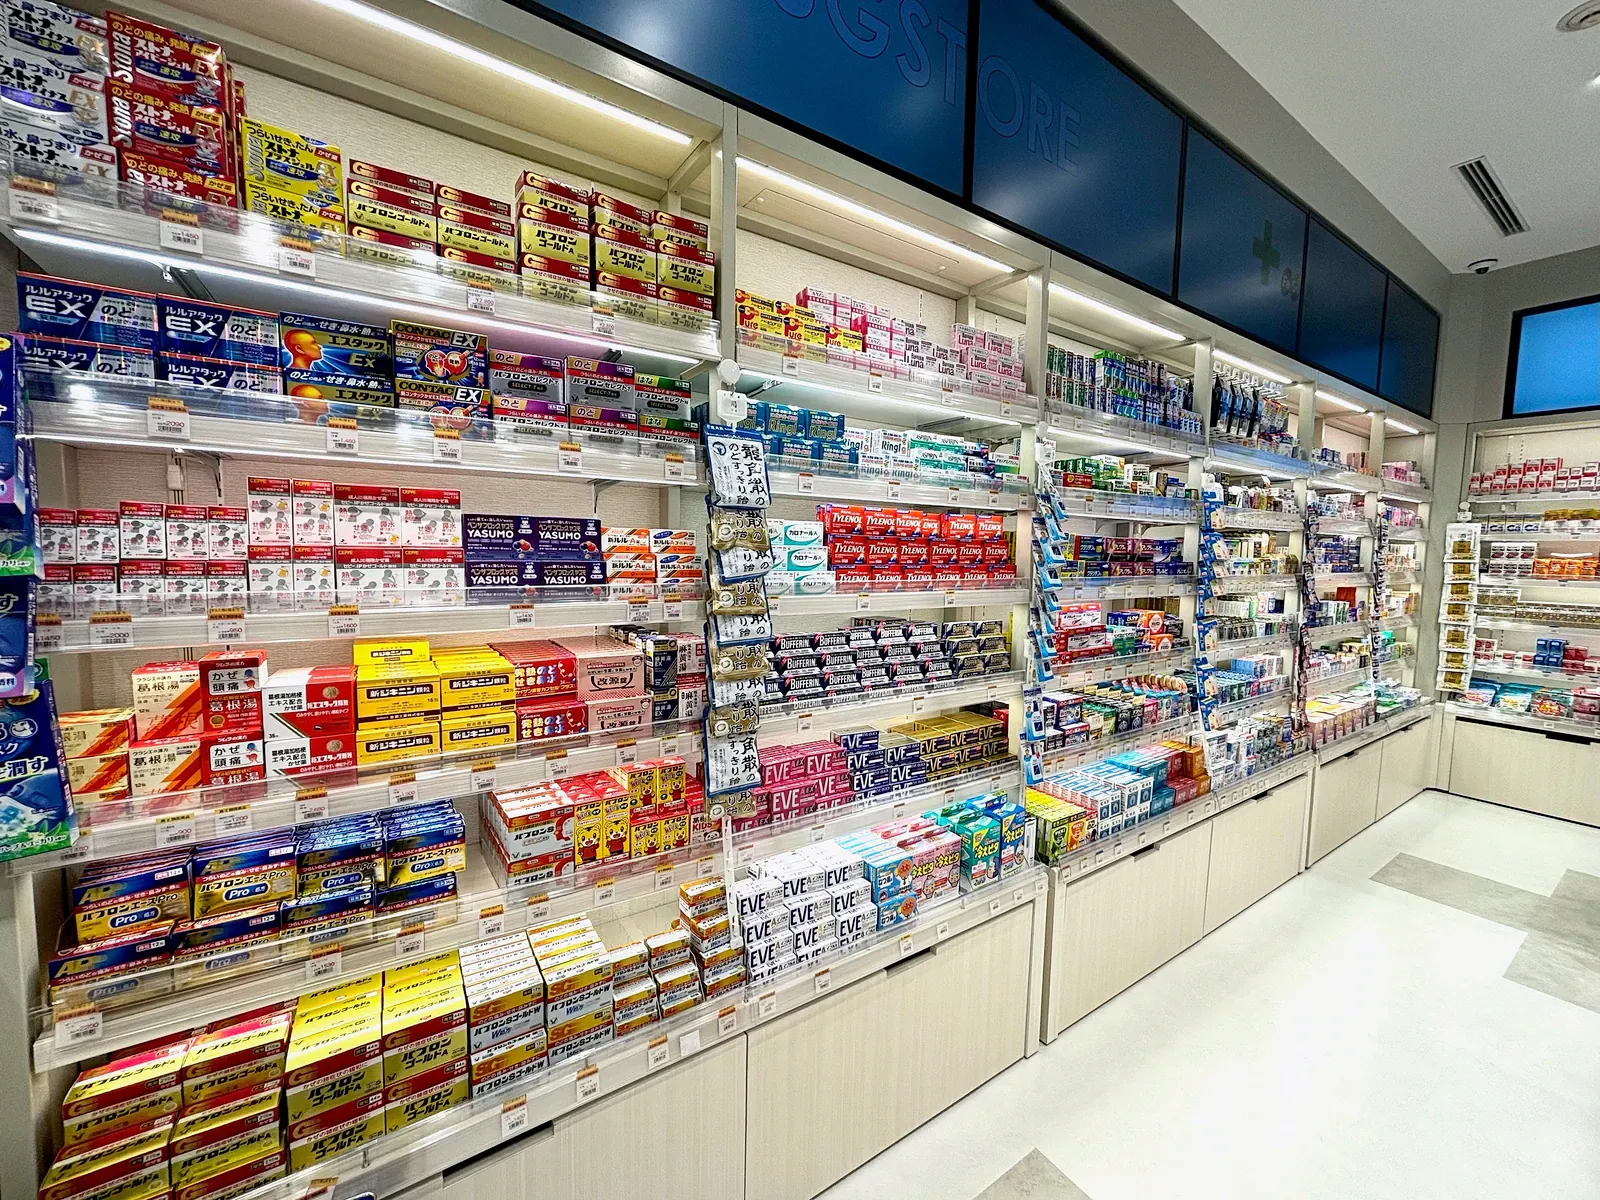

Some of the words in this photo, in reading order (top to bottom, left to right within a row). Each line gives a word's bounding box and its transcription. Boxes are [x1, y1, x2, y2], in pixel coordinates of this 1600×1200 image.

[356, 203, 430, 230] パブロンゴールドA
[536, 229, 577, 246] パブロン
[538, 238, 575, 255] ゴールドA
[608, 247, 646, 264] パブロン
[670, 262, 704, 278] パブロン
[25, 284, 92, 303] ルルアタック
[26, 295, 86, 318] EX
[166, 306, 224, 322] ルルアタック
[166, 316, 217, 336] EX
[395, 324, 450, 339] CONTAC
[452, 335, 478, 348] EX
[495, 353, 515, 363] のど
[574, 359, 593, 370] のど
[168, 364, 227, 379] ルルアタック
[637, 375, 654, 385] はな
[399, 382, 454, 396] CONTAC
[455, 388, 481, 402] EX
[500, 399, 520, 409] のど
[577, 407, 595, 417] のど
[645, 416, 662, 426] はな
[881, 440, 901, 454] Ringl
[832, 513, 864, 523] TYLENOL
[866, 516, 896, 526] TYLENOL
[950, 522, 975, 530] TYLENOL
[979, 523, 1003, 531] TYLENOL
[467, 530, 514, 539] YASUMO
[539, 531, 581, 540] YASUMO
[835, 543, 866, 553] TYLENOL
[869, 544, 899, 554] TYLENOL
[986, 547, 1008, 555] TYLENOL
[471, 576, 518, 585] YASUMO
[544, 576, 587, 585] YASUMO
[212, 671, 238, 681] かぜ
[136, 681, 180, 693] 葛根湯
[212, 682, 239, 692] 頭痛
[209, 698, 257, 712] 葛根湯
[978, 725, 995, 741] EVE
[841, 734, 863, 751] EVE
[213, 745, 240, 756] かぜ
[133, 752, 176, 766] 葛根湯
[213, 756, 241, 768] 頭痛
[806, 752, 832, 774] EVE
[765, 761, 790, 785] EVE
[891, 766, 912, 783] EVE
[772, 788, 801, 812] EVE
[827, 866, 849, 887] EVE
[784, 877, 807, 898] EVE
[740, 893, 766, 917] EVE
[834, 891, 856, 913] EVE
[840, 915, 862, 938] EVE
